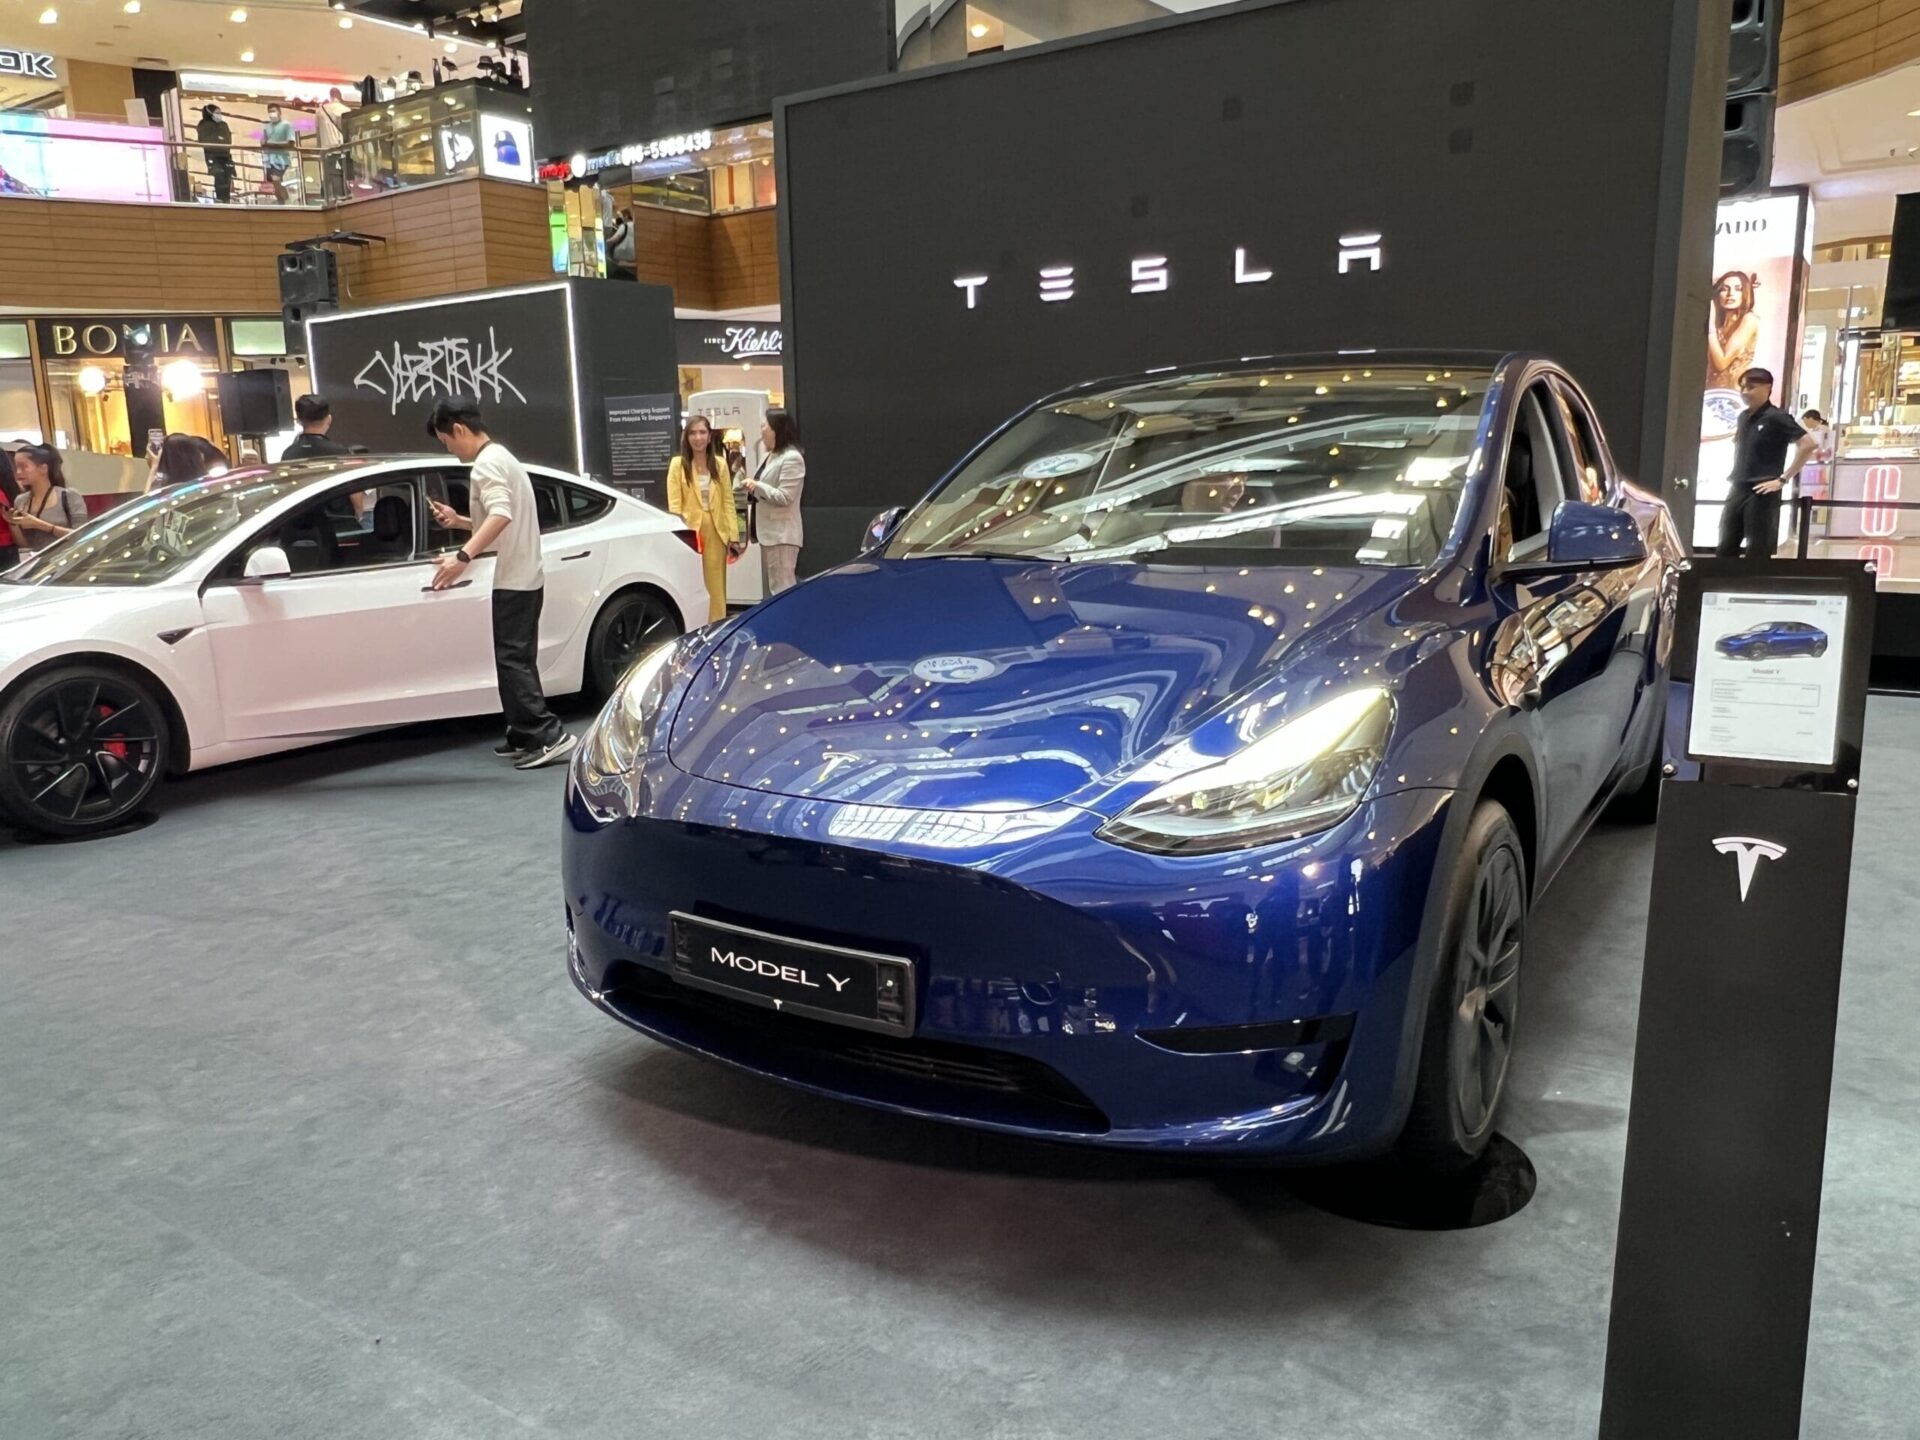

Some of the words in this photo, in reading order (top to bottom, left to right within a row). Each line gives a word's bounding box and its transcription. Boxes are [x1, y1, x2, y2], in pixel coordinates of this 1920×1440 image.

[953, 233, 1382, 309] TESLA
[698, 406, 741, 416] TESLA
[710, 946, 820, 988] MODEL
[826, 972, 851, 992] Y
